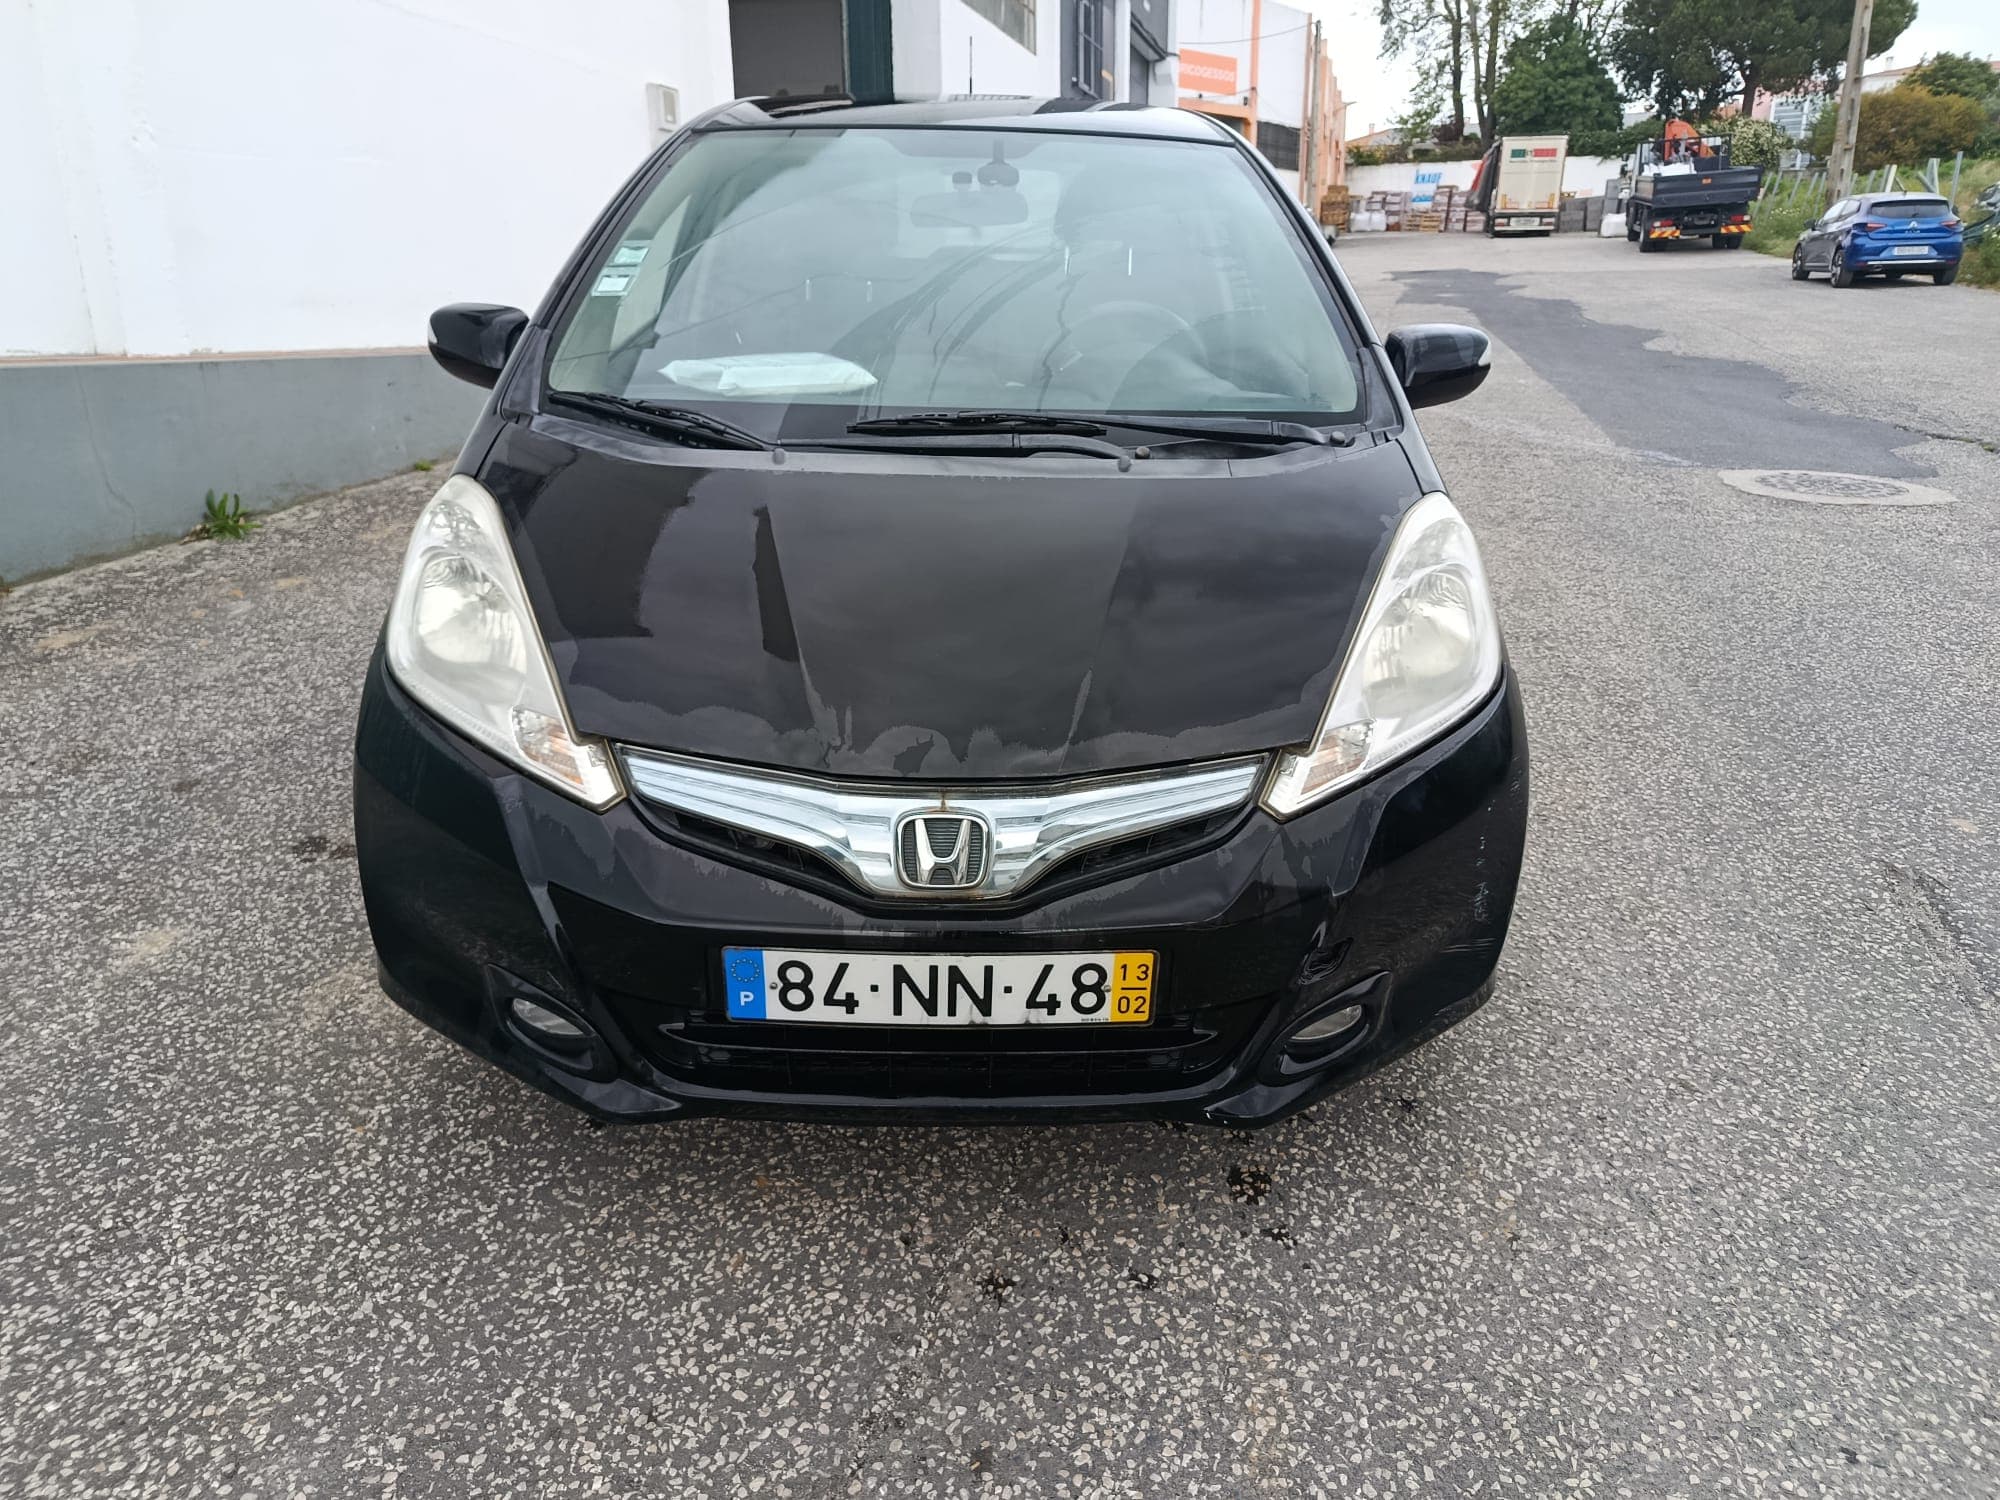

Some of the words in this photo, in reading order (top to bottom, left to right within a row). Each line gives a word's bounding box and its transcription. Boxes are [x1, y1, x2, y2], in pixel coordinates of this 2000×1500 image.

[1120, 963, 1149, 981] 13
[740, 991, 754, 1006] P
[1117, 995, 1146, 1014] 02
